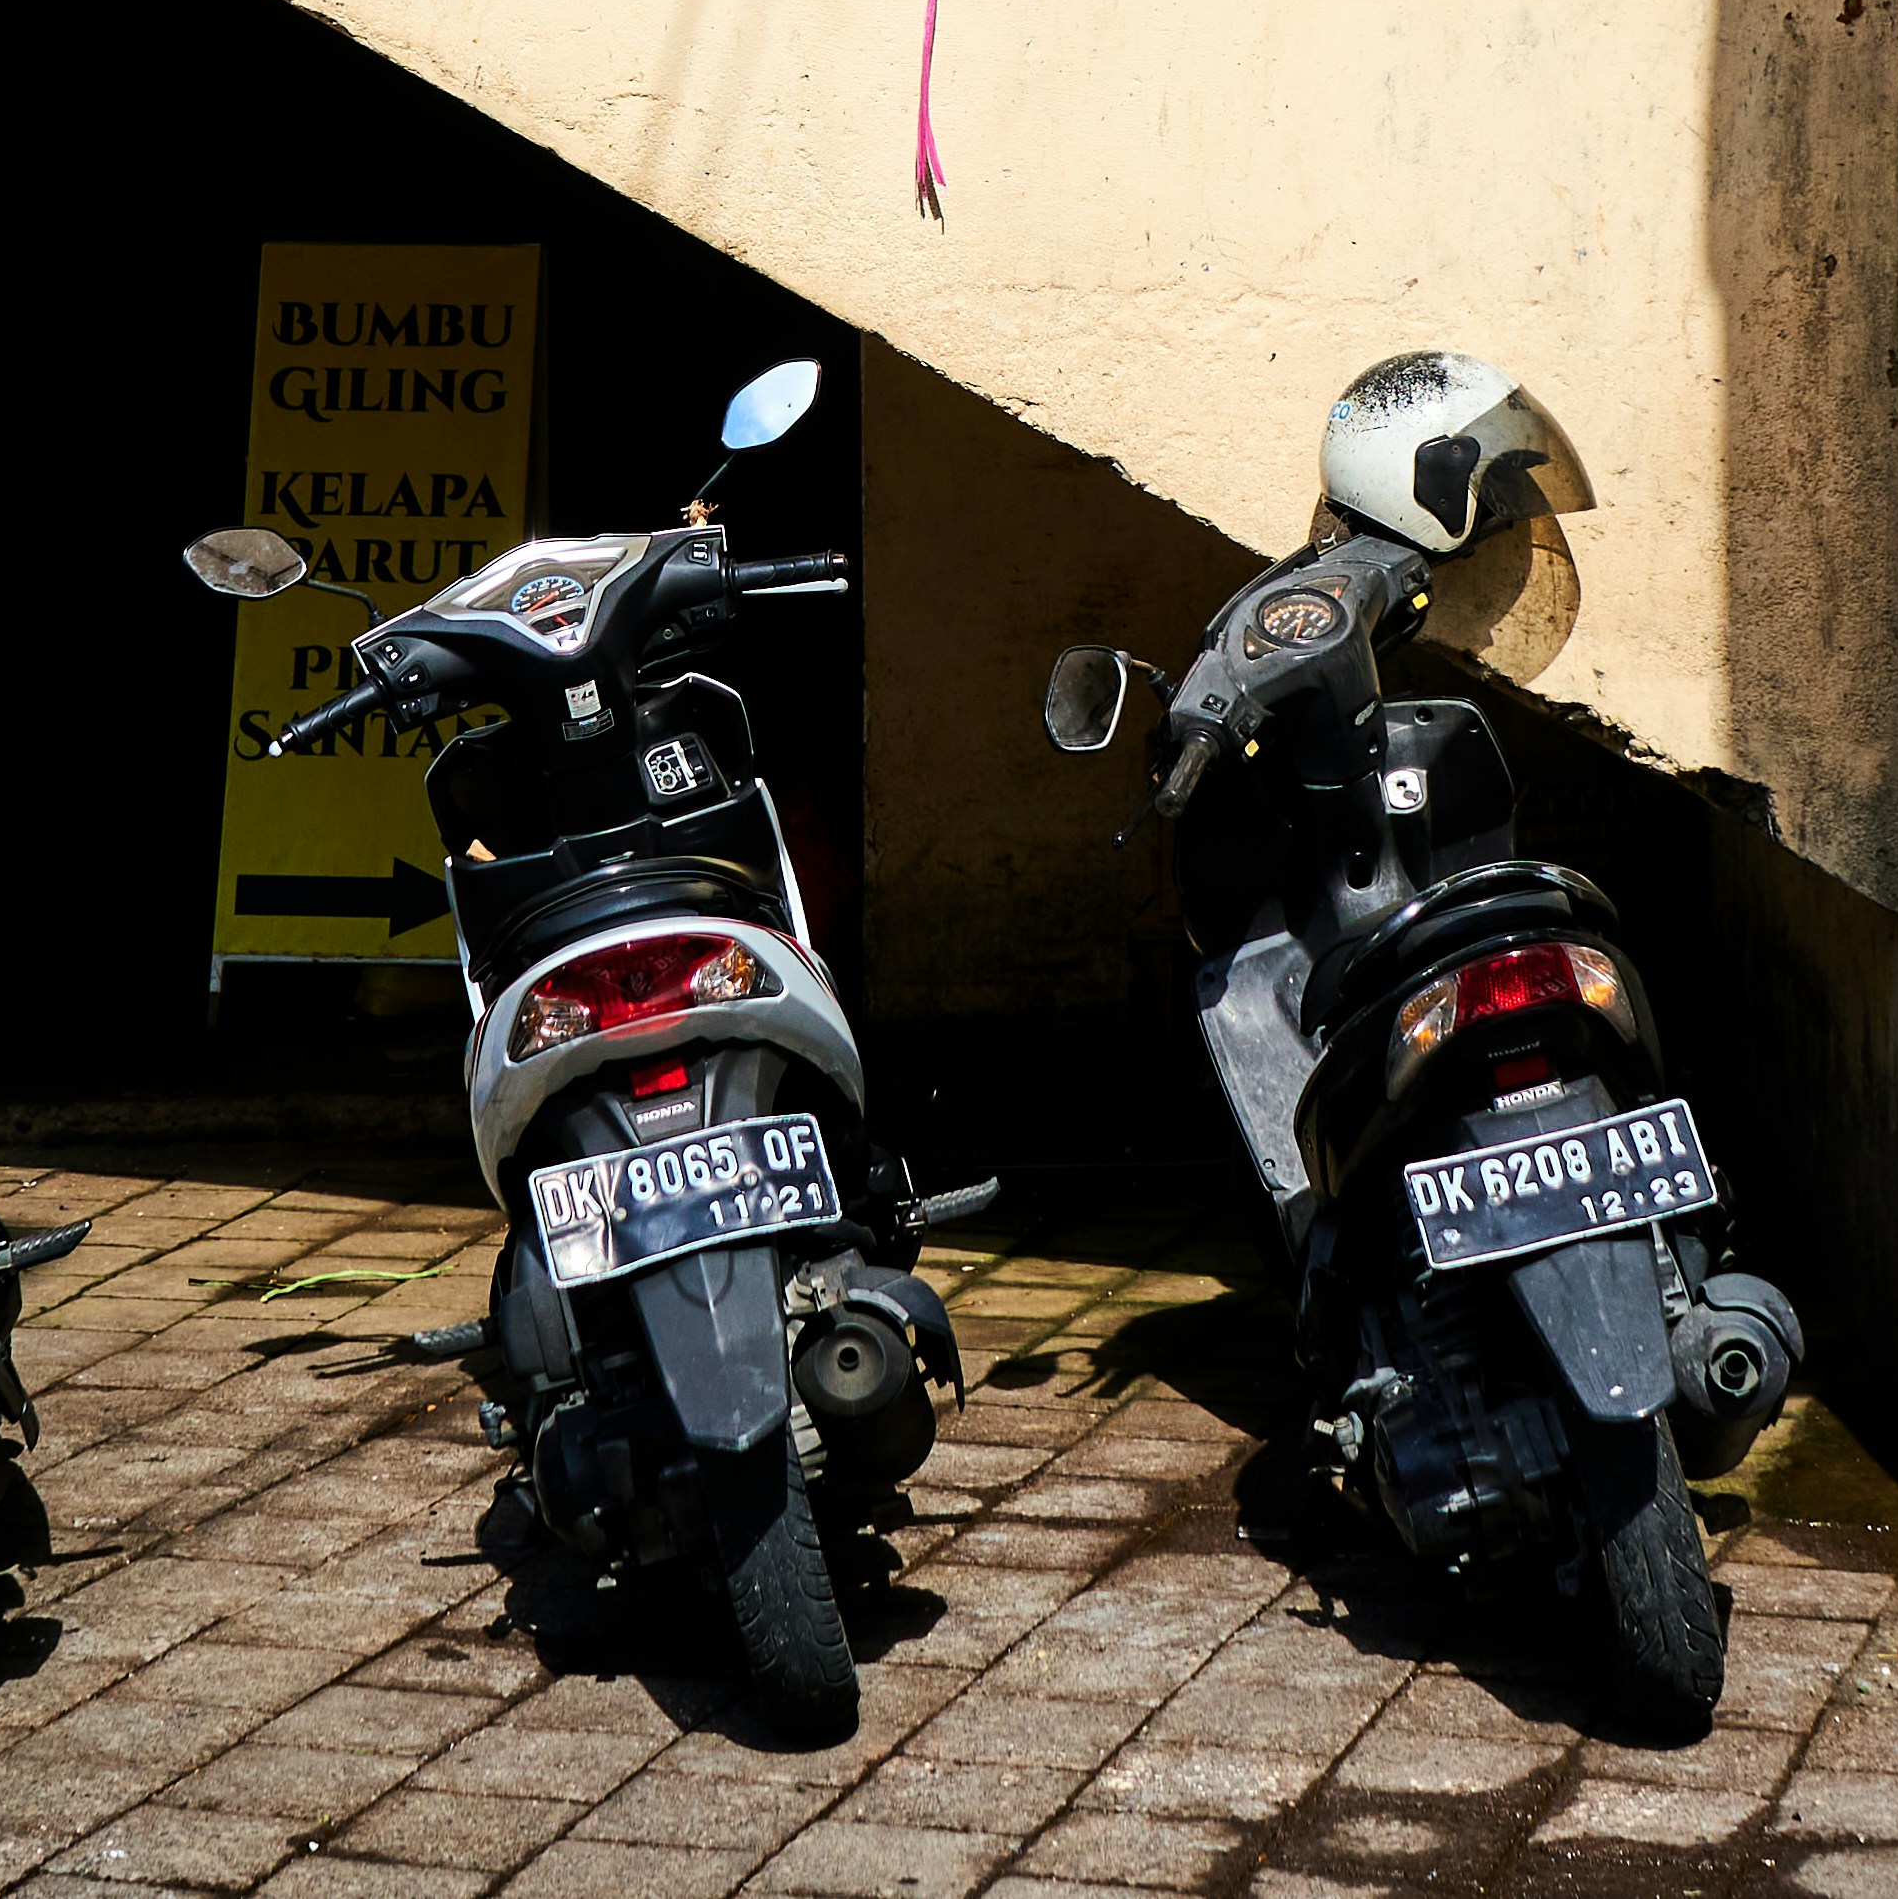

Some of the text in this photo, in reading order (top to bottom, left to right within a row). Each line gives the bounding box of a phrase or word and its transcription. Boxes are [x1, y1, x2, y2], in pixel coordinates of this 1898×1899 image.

[272, 301, 517, 349] BUMBU
[269, 366, 510, 423] GILING
[260, 471, 508, 530] KELAPA
[635, 1100, 696, 1125] HONDA
[1496, 1083, 1563, 1110] HONDA
[539, 1168, 603, 1229] DK
[626, 1134, 740, 1202] 8065
[1410, 1110, 1687, 1216] DK 6208 ABI
